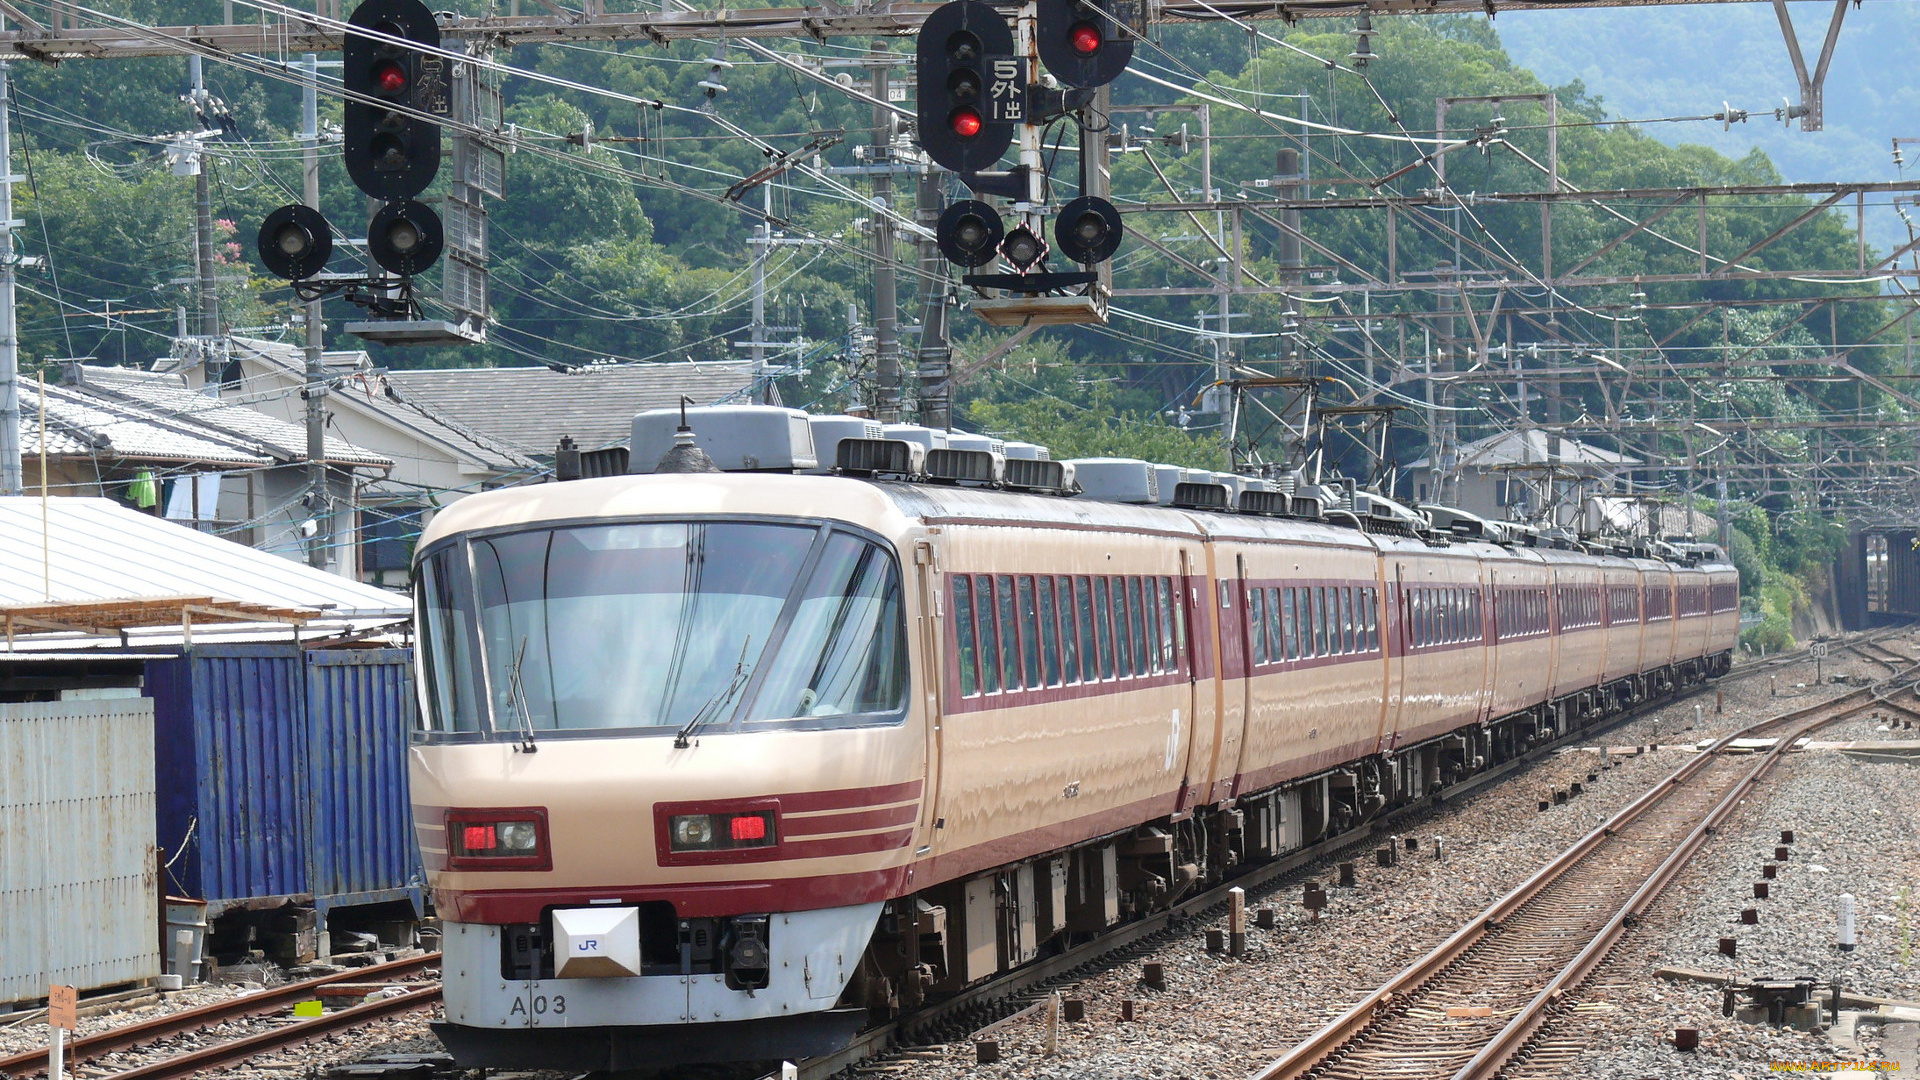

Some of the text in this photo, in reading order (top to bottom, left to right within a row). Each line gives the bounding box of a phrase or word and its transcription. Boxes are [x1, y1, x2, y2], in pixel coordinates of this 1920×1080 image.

[994, 60, 1018, 79] 5
[990, 81, 1021, 99] 外
[1812, 645, 1825, 656] 60
[578, 940, 597, 951] JR
